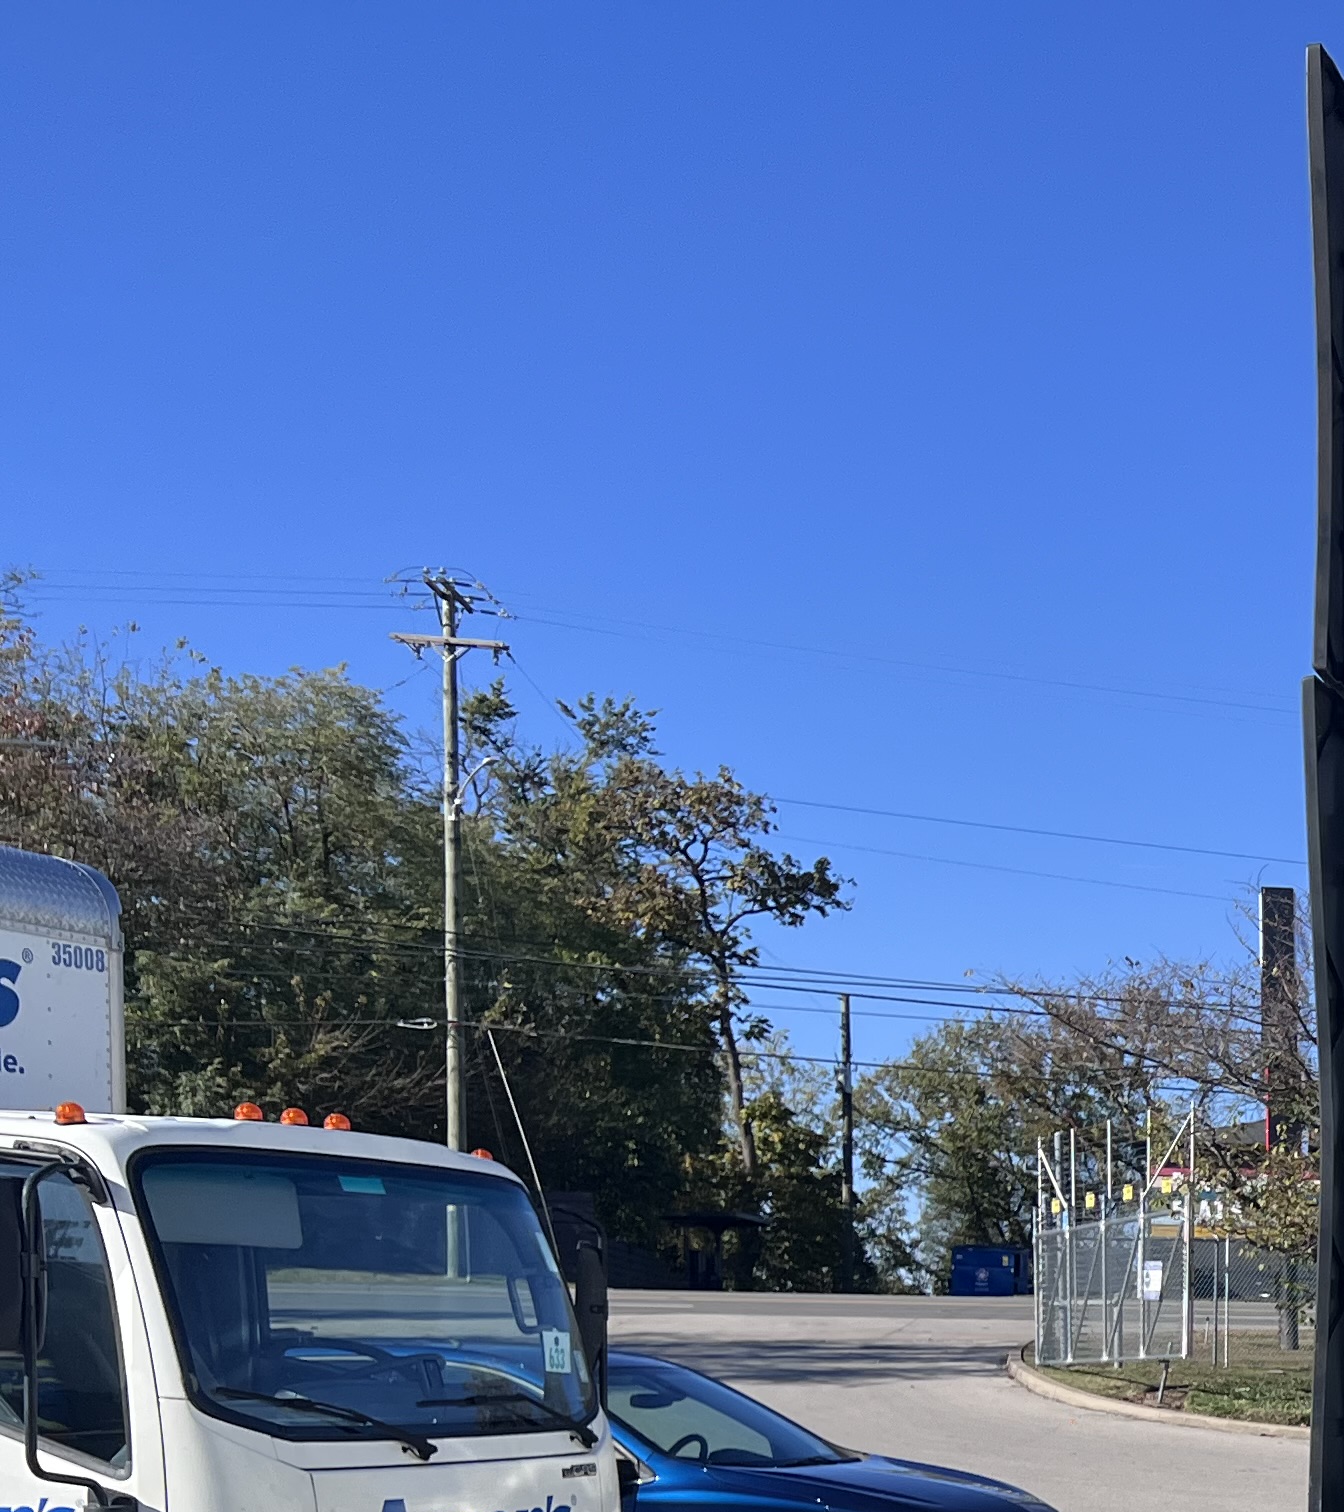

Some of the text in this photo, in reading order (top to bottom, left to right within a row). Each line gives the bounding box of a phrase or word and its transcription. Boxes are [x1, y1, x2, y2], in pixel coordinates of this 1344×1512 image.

[51, 941, 105, 973] 35008
[0, 1052, 25, 1074] e.
[549, 1347, 566, 1370] 633
